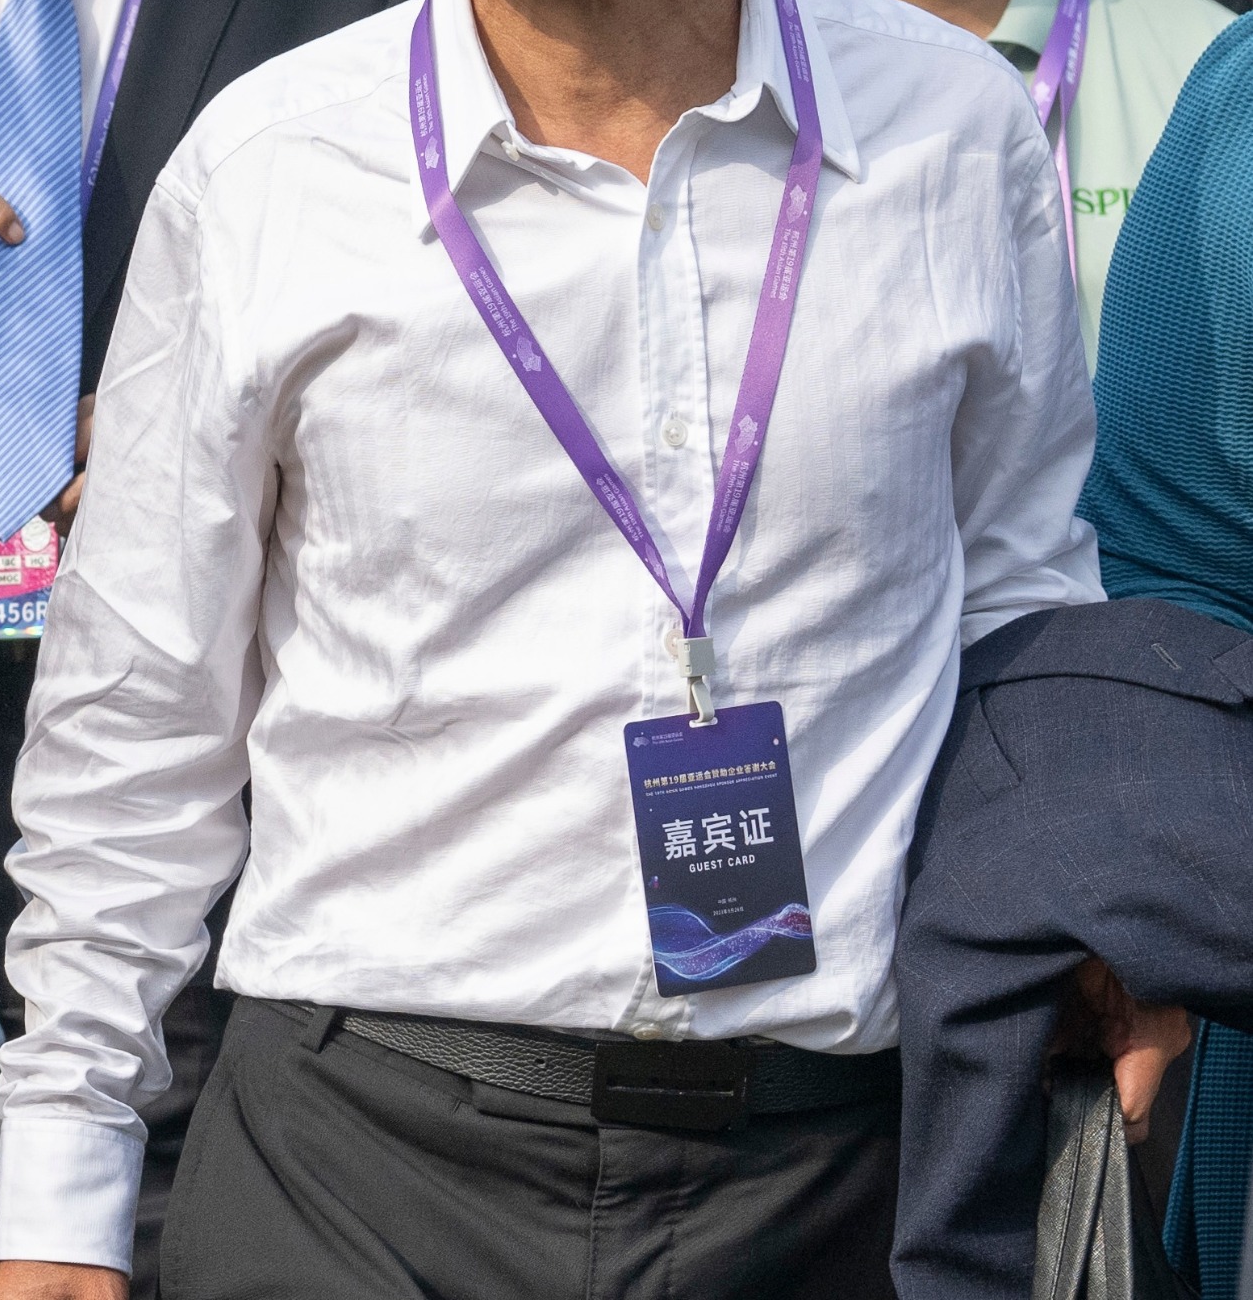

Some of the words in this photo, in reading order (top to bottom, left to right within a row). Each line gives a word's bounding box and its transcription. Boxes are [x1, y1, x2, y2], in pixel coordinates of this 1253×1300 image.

[778, 230, 800, 300] 杭州第19届亚运会
[470, 271, 512, 337] 杭州第19届亚运会
[509, 318, 520, 332] The
[596, 478, 639, 541] 杭州第19届亚运会
[723, 461, 749, 533] 杭州第19届亚运会
[662, 807, 775, 861] 嘉宾证
[689, 859, 723, 873] GUEST
[727, 854, 756, 868] CARD
